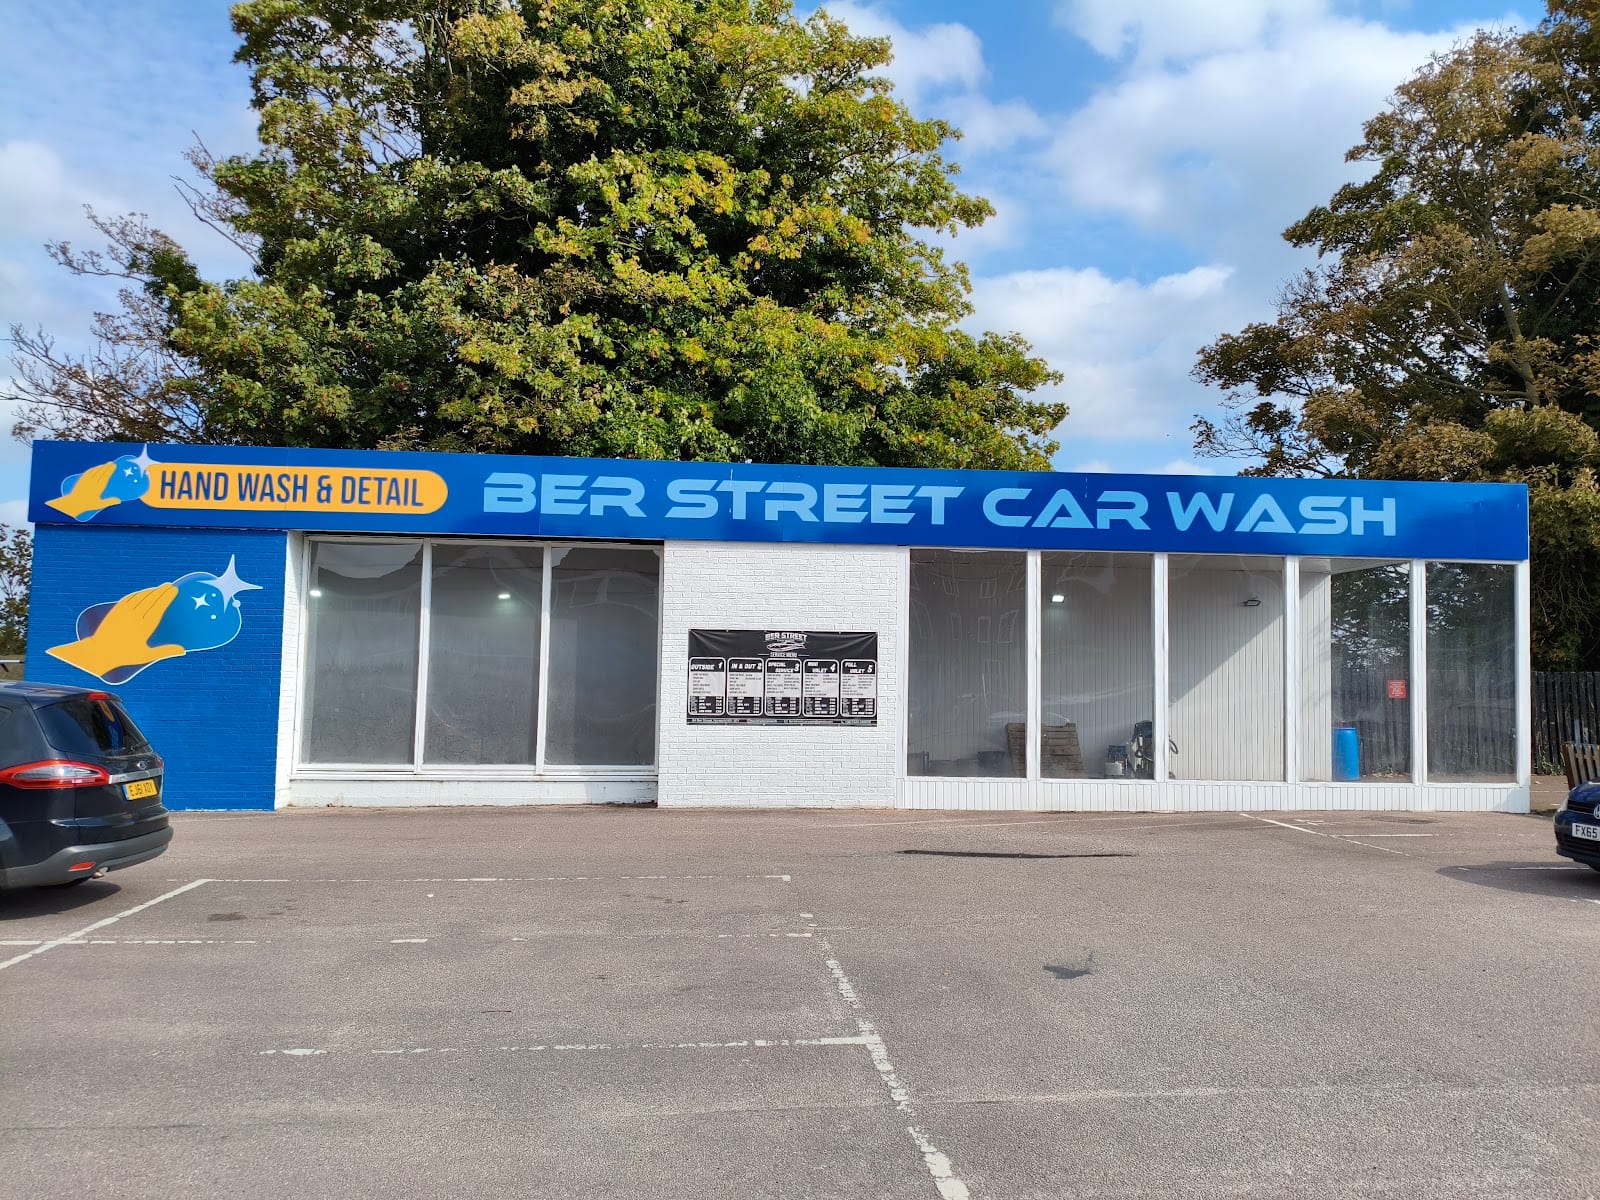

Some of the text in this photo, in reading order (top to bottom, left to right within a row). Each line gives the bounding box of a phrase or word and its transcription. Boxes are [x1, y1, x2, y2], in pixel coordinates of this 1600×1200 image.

[159, 470, 424, 507] HAND WASH & DETAIL
[483, 472, 1397, 537] BER STREET CAR WASH
[781, 632, 808, 642] STREET
[690, 661, 724, 671] OUTSIDE 1
[756, 662, 763, 670] 2
[794, 663, 800, 672] 3
[829, 663, 837, 673] 4
[866, 664, 874, 673] 5
[1575, 825, 1598, 839] FX65
